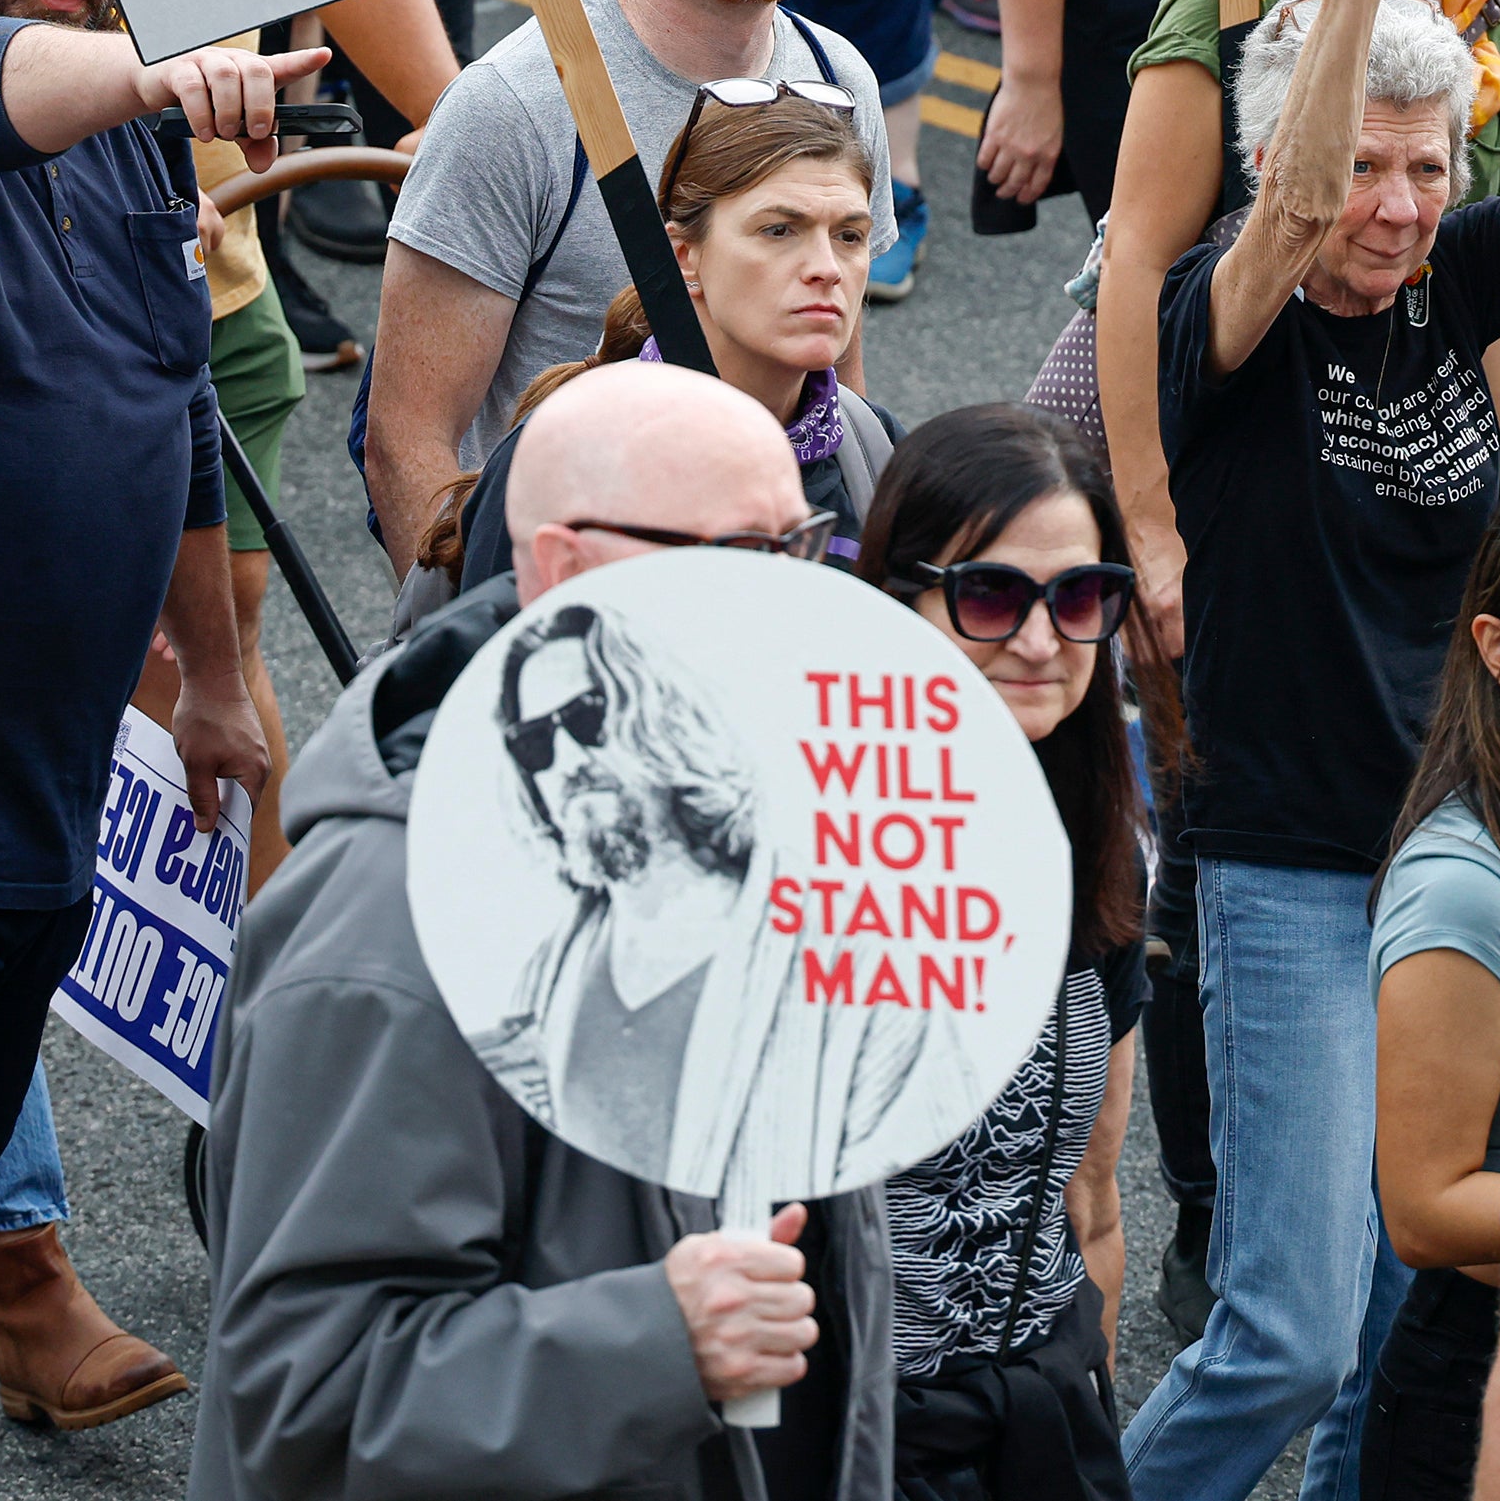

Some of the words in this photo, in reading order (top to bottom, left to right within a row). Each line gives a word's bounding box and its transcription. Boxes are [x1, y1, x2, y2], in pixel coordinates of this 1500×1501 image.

[1318, 388, 1350, 405] our
[1393, 412, 1432, 438] eing
[1458, 368, 1477, 388] in
[1328, 363, 1355, 384] We
[1402, 390, 1428, 410] are
[1321, 409, 1373, 432] white
[1320, 448, 1394, 477] Sustained
[1399, 466, 1421, 488] by
[1447, 446, 1491, 481] silence
[1375, 482, 1446, 506] enables
[1447, 475, 1485, 502] both.
[805, 672, 960, 733] THIS
[800, 742, 975, 803] WILL
[97, 758, 162, 885] ICE
[814, 812, 966, 870] NOT
[153, 803, 247, 953] uera
[770, 878, 1016, 953] STAND,
[149, 946, 226, 1070] ICE
[802, 950, 987, 1013] MAN!
